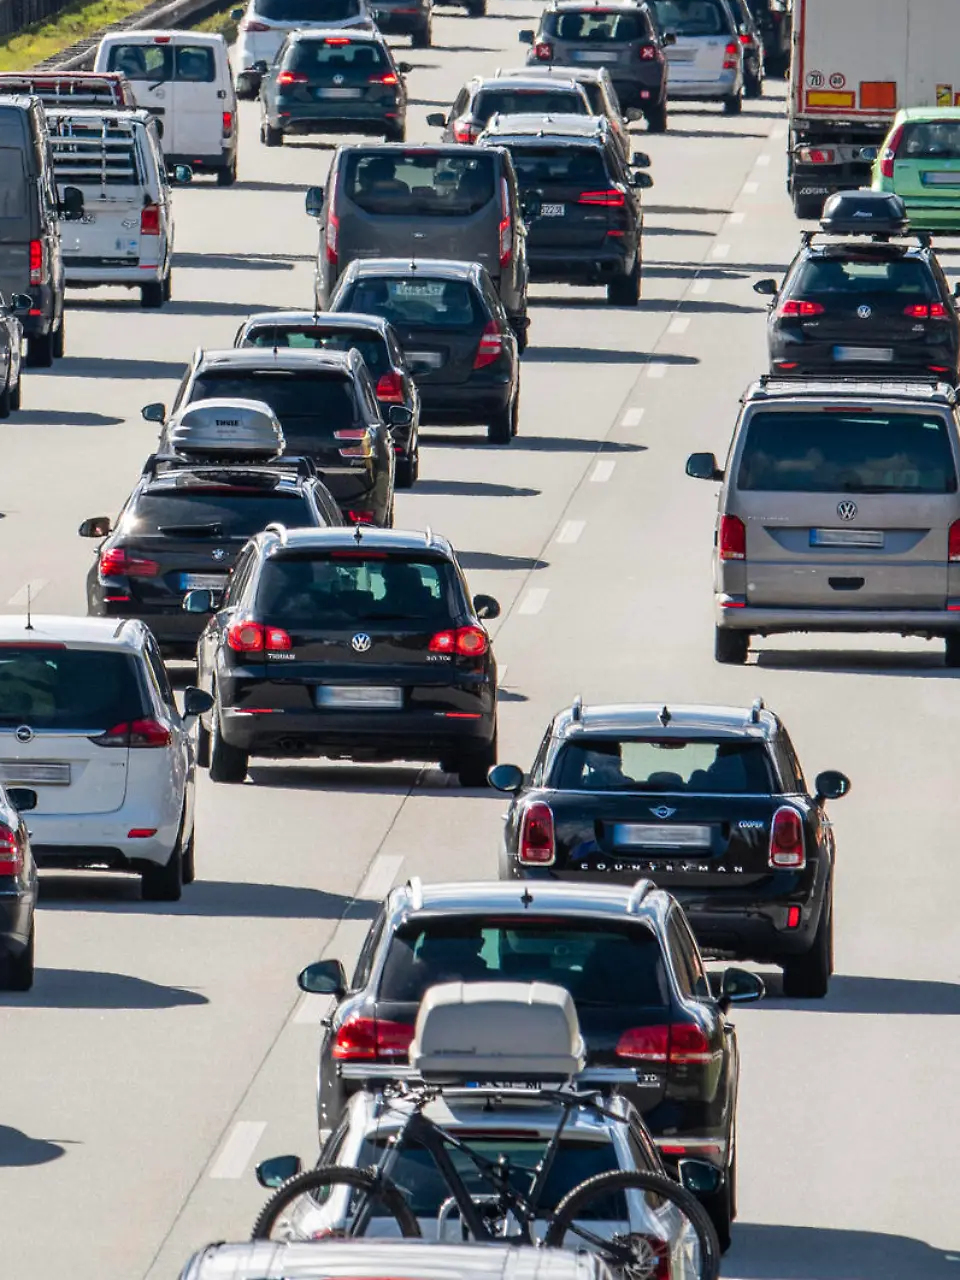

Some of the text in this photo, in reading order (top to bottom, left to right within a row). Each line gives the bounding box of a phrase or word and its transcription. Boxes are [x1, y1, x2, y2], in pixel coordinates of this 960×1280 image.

[215, 419, 241, 427] THULE
[738, 820, 764, 828] COOPER
[580, 861, 744, 873] COUNTRYMAN
